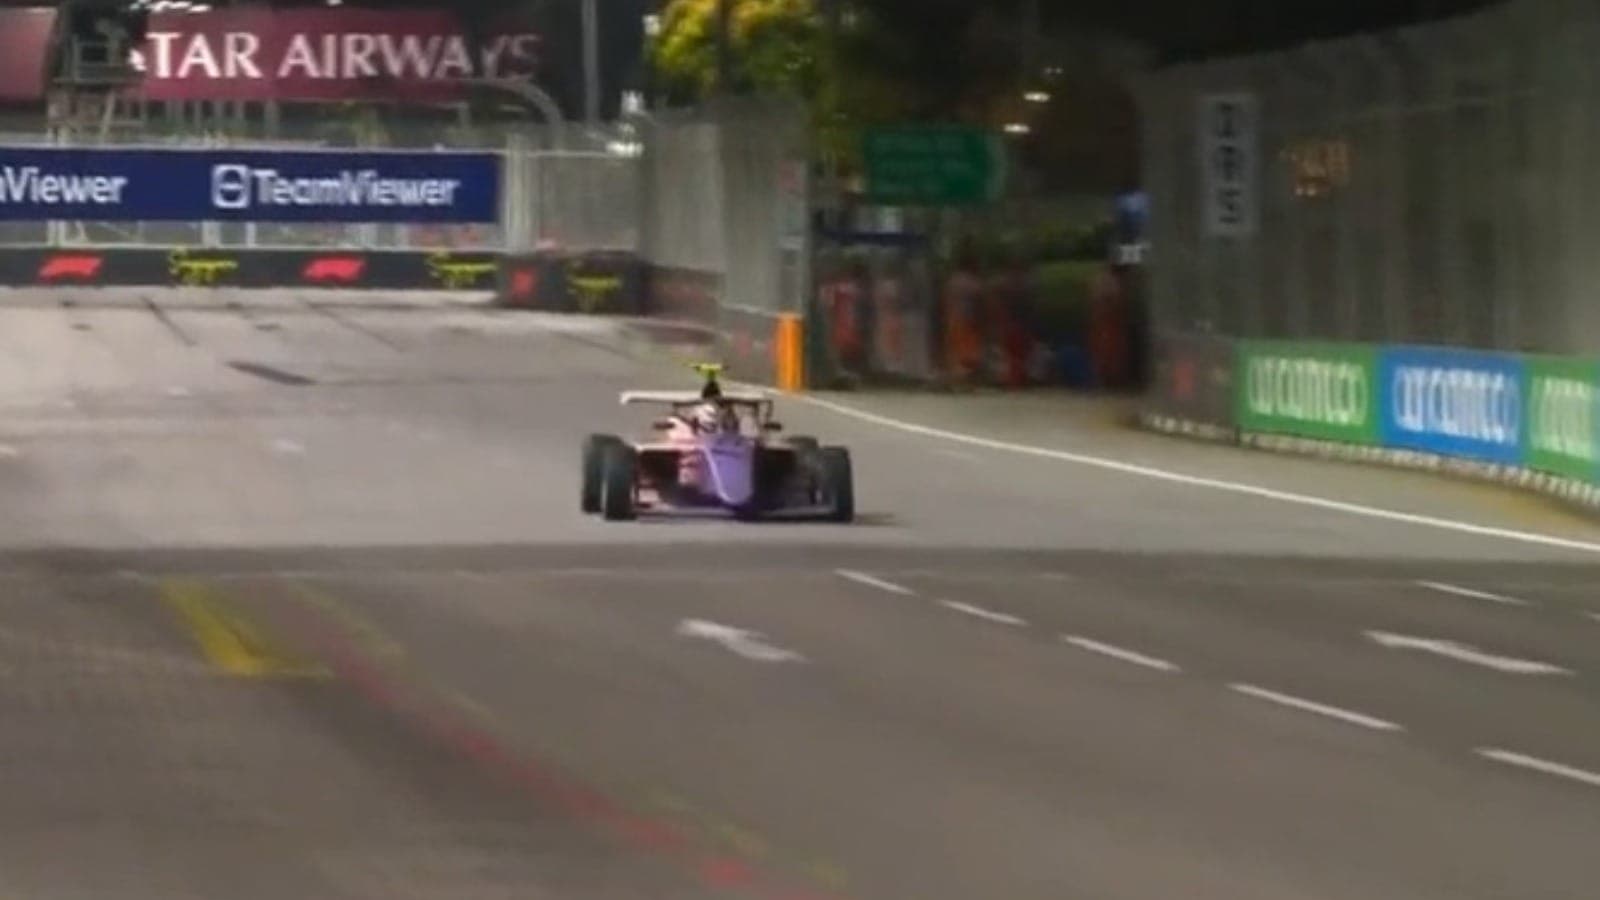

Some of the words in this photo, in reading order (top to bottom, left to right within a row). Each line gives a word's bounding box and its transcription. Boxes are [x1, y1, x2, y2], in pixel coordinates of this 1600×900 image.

[129, 32, 263, 79] TAR
[277, 33, 542, 79] AIRWAYS
[0, 166, 128, 203] Viewer
[253, 168, 461, 205] TeamViewer
